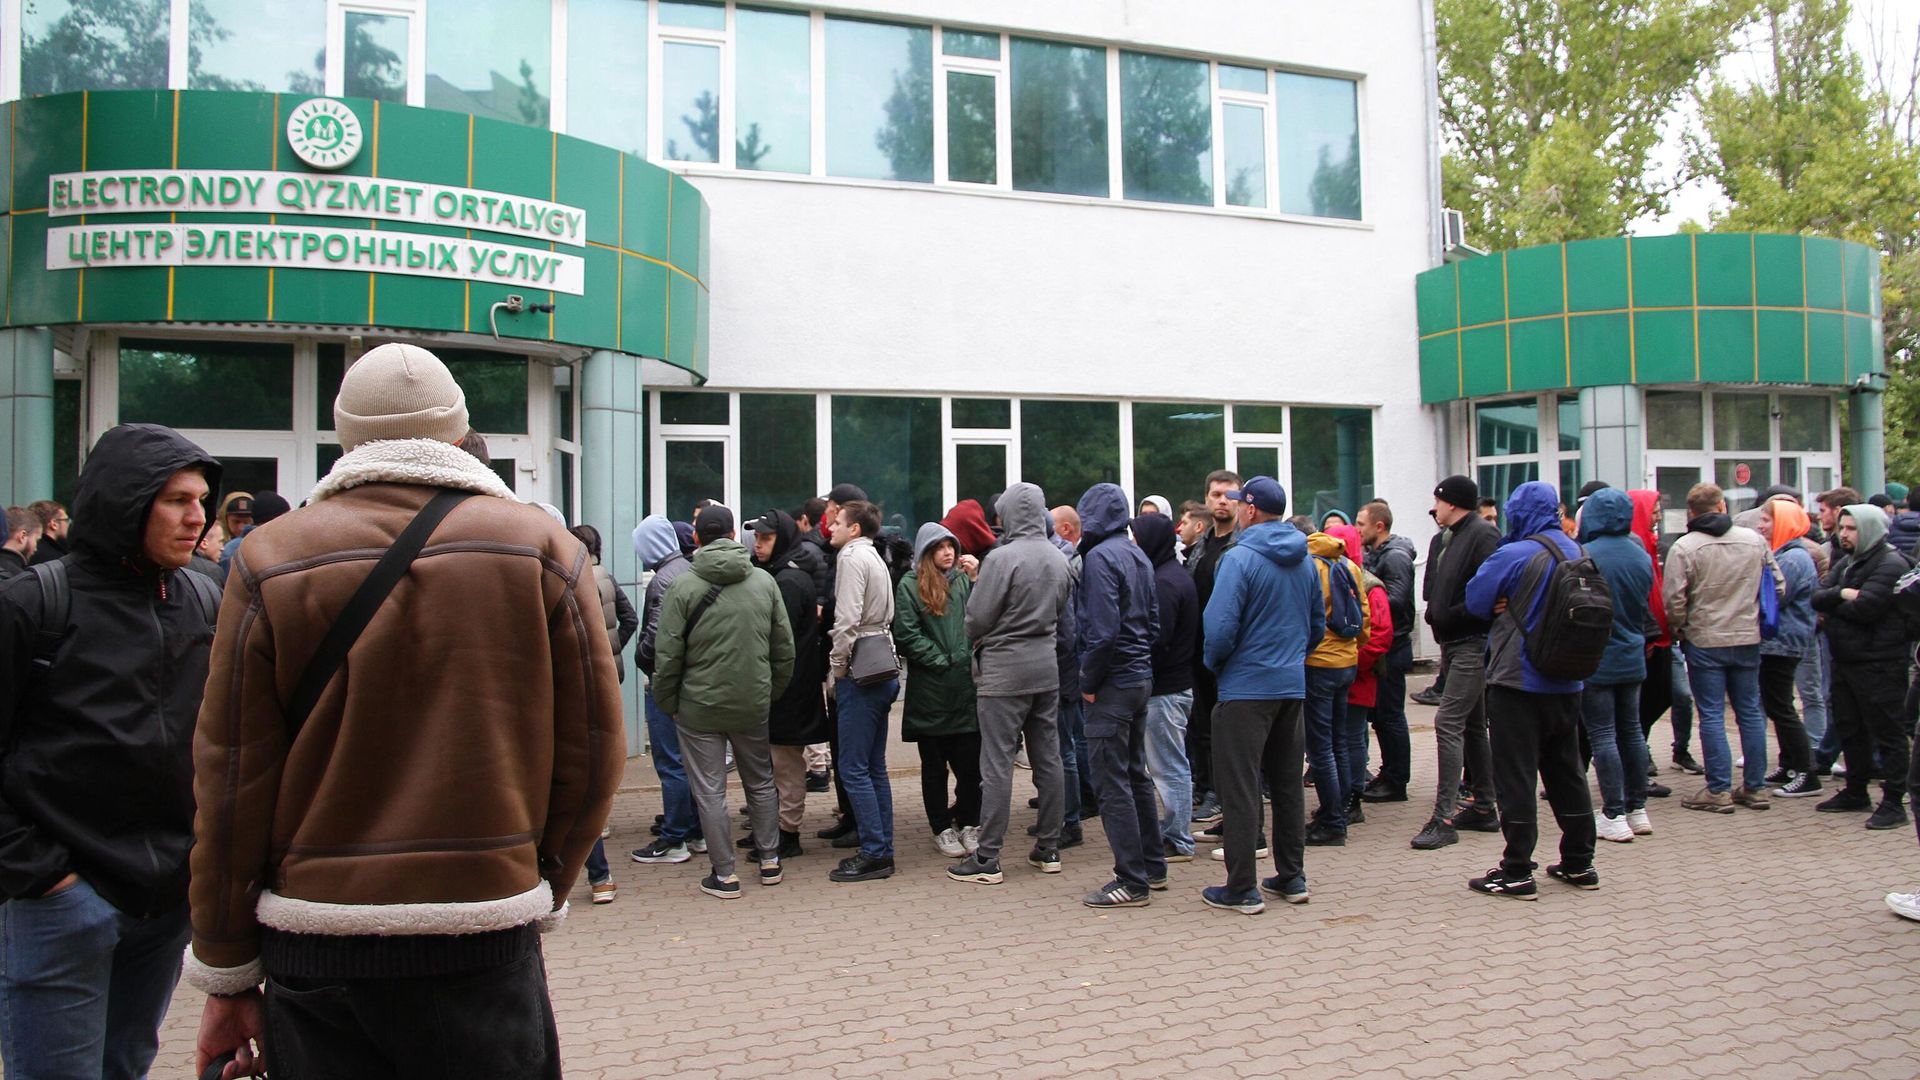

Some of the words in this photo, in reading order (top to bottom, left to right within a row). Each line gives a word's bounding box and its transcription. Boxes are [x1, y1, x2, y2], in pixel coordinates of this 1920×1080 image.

[52, 175, 266, 209] ELECTRONDY
[277, 178, 423, 215] QYZMET
[433, 191, 582, 239] ORTALYGY
[68, 230, 174, 266] ЦЕНТР
[186, 229, 459, 272] ЭЛЕКТРОННЫХ
[469, 246, 563, 284] УСЛУГ
